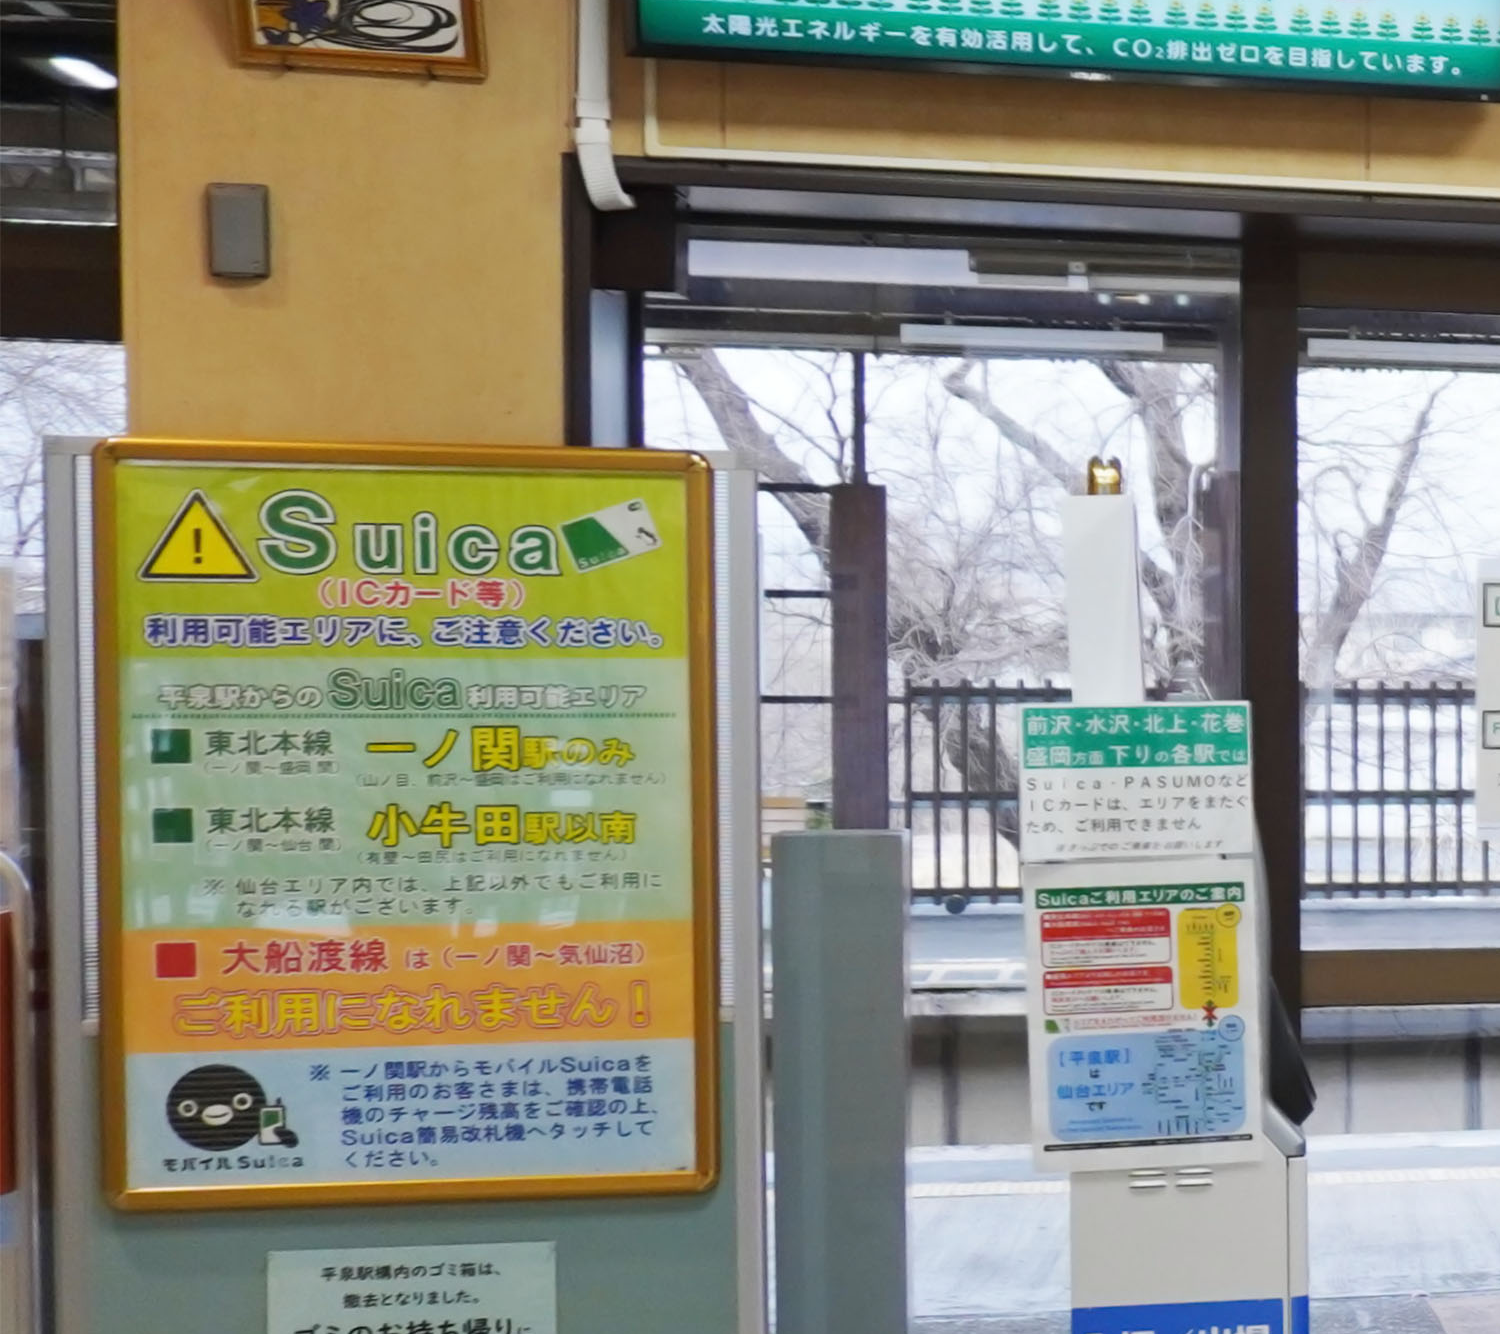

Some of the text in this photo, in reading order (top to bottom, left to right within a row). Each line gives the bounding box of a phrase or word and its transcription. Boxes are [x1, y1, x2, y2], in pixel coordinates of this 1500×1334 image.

[256, 489, 561, 577] Suica
[146, 616, 664, 648] 利用可能エリアに、ご注意ください。
[159, 669, 646, 711] 平泉駅からの Suica 利用可能エリア
[1026, 712, 1246, 736] 前沢・水沢・北上・花巻
[204, 726, 635, 772] 東北本線 一ノ関駅のみ
[1028, 794, 1248, 812] ICカードは、エリアをまたぐ
[206, 804, 638, 848] 東北本線 小牛田駅以南
[1026, 816, 1202, 834] ため、ご利用できません
[1038, 886, 1241, 906] Suicaご利用エリアのご案内
[222, 939, 390, 976] 大船渡線
[341, 1076, 653, 1103] ご利用のお客さまは、携帯電話
[1057, 1082, 1135, 1099] 仙台エリア
[341, 1098, 660, 1125] 機のチャージ残高をご確認の上、
[341, 1119, 653, 1147] Suica簡易改札機へタッチして
[343, 1149, 441, 1169] ください。
[320, 1262, 502, 1282] 平泉駅構内のゴミ箱は、
[343, 1291, 480, 1308] 撤去となりました。
